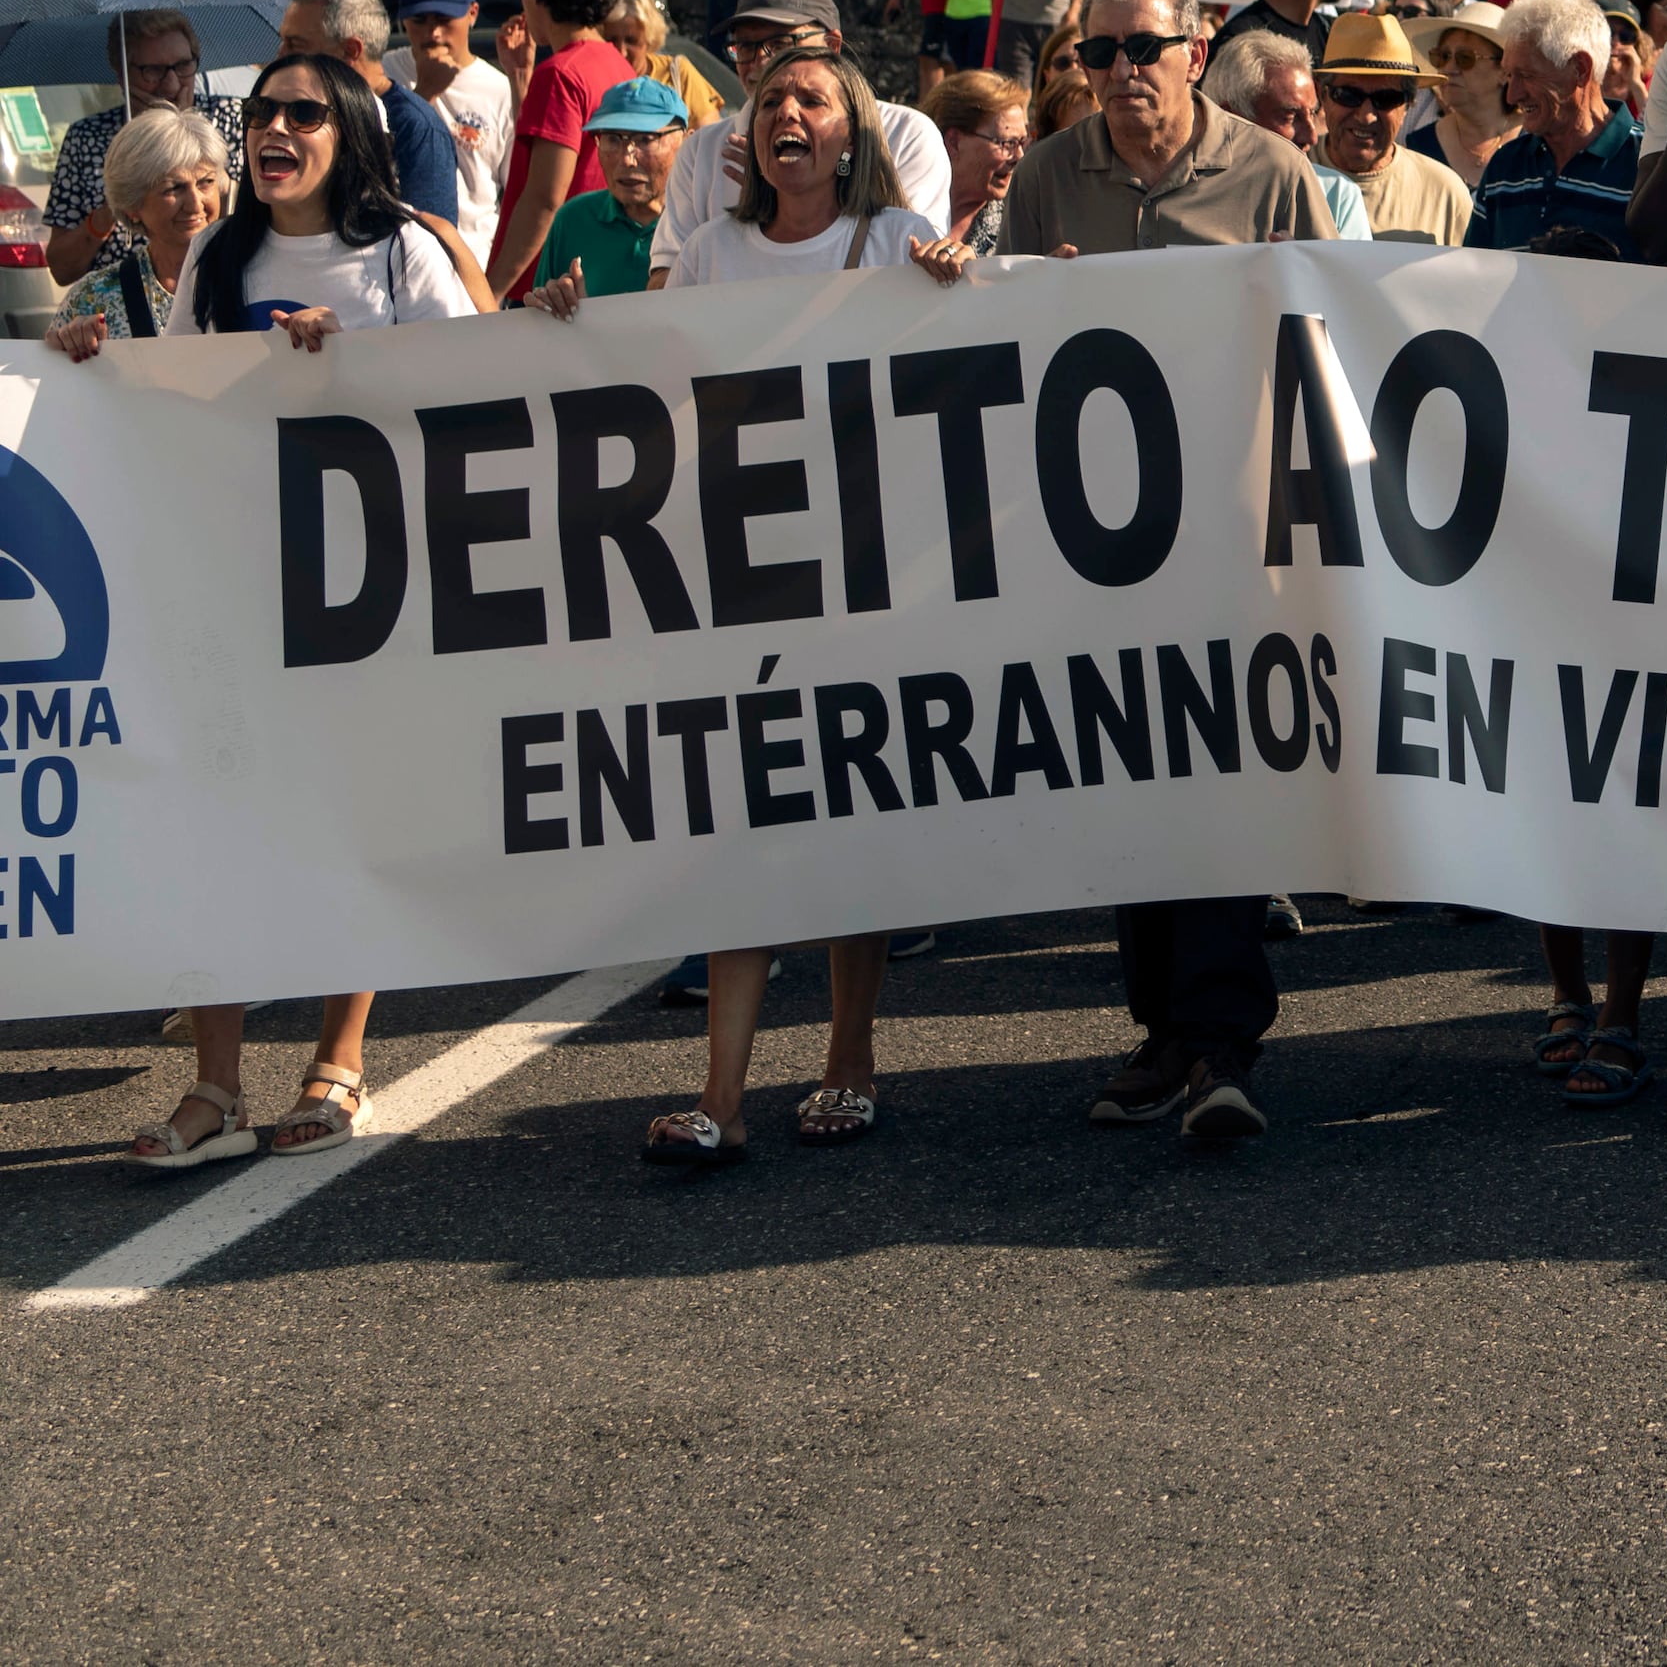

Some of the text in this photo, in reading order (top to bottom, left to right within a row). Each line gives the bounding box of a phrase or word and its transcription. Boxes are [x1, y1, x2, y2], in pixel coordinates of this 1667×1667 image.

[276, 327, 1183, 668] DEREITO
[1263, 313, 1509, 587] AO
[501, 630, 1342, 855] ENTÉRRANNOS
[1376, 637, 1515, 794] EN
